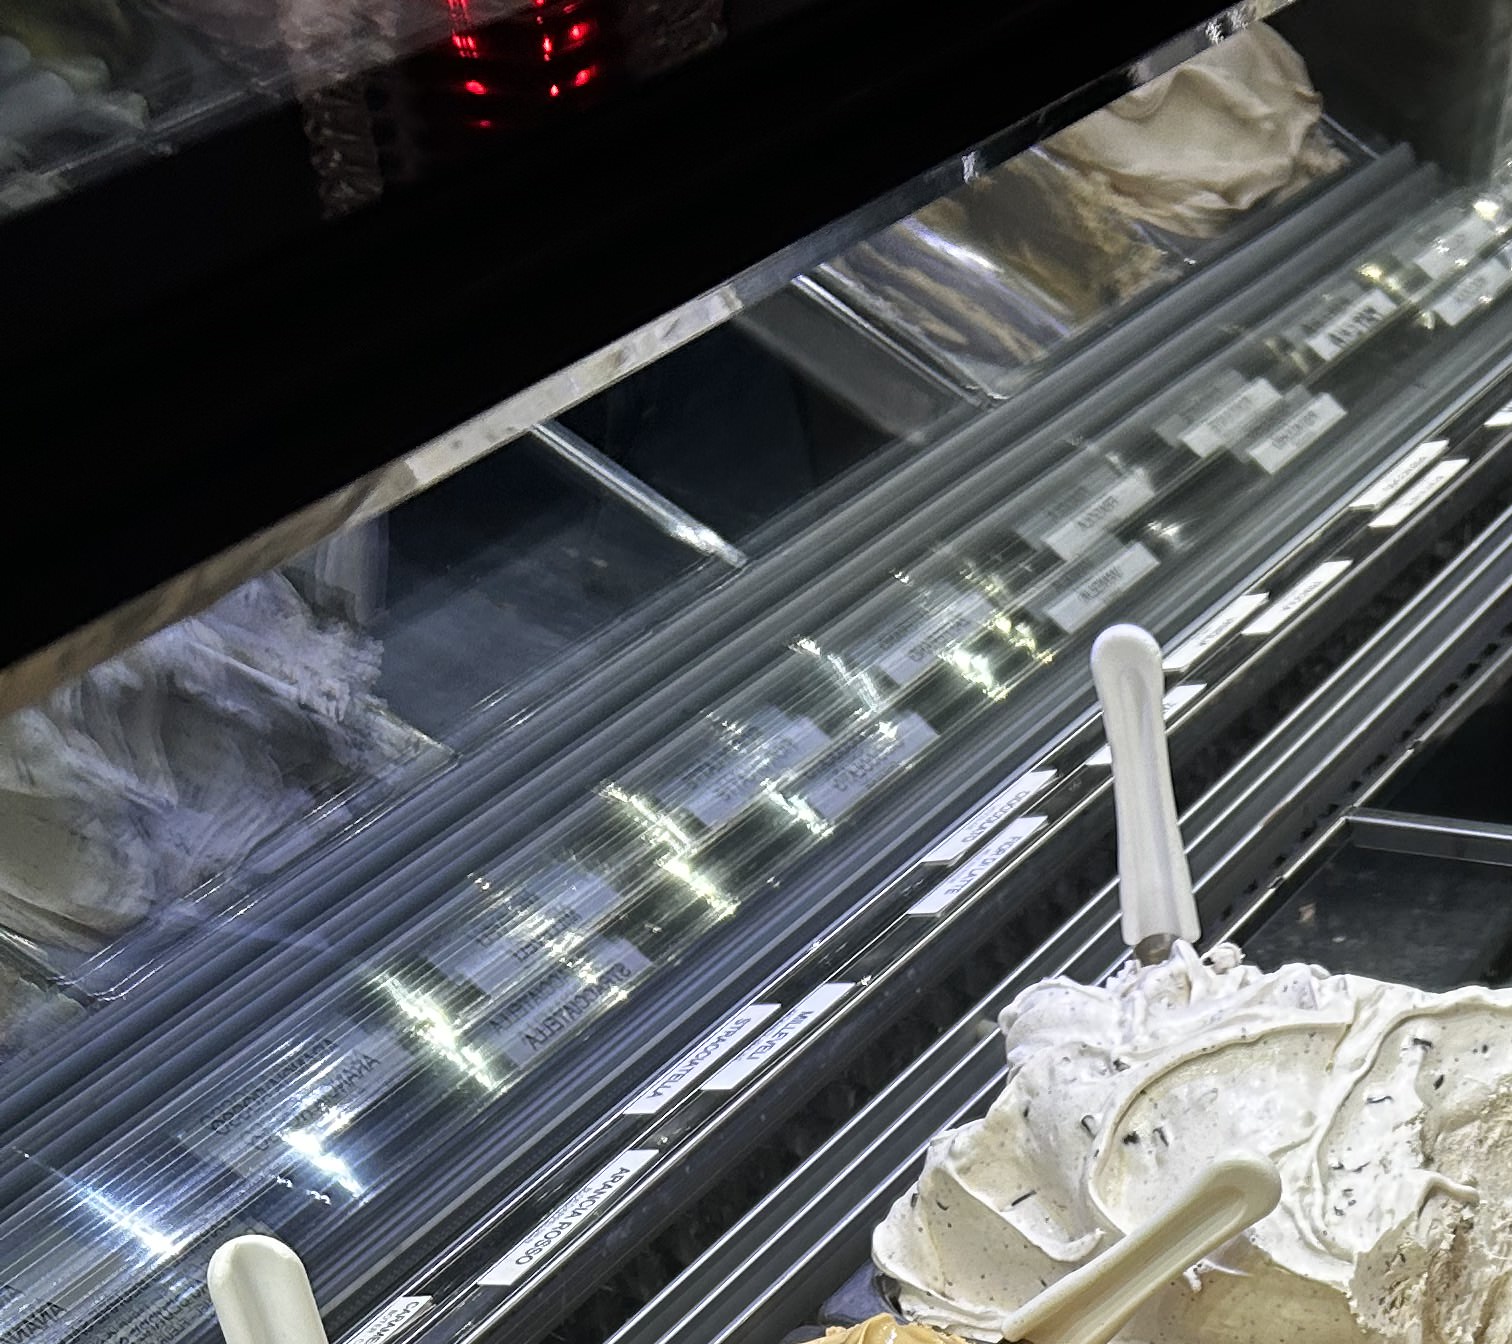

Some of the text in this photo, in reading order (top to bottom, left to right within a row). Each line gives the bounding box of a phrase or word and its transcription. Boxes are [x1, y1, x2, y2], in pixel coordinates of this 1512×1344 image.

[646, 1016, 751, 1099] STRACCIATELLA
[564, 1166, 631, 1219] ARANCIA
[515, 1221, 573, 1265] ROSSO
